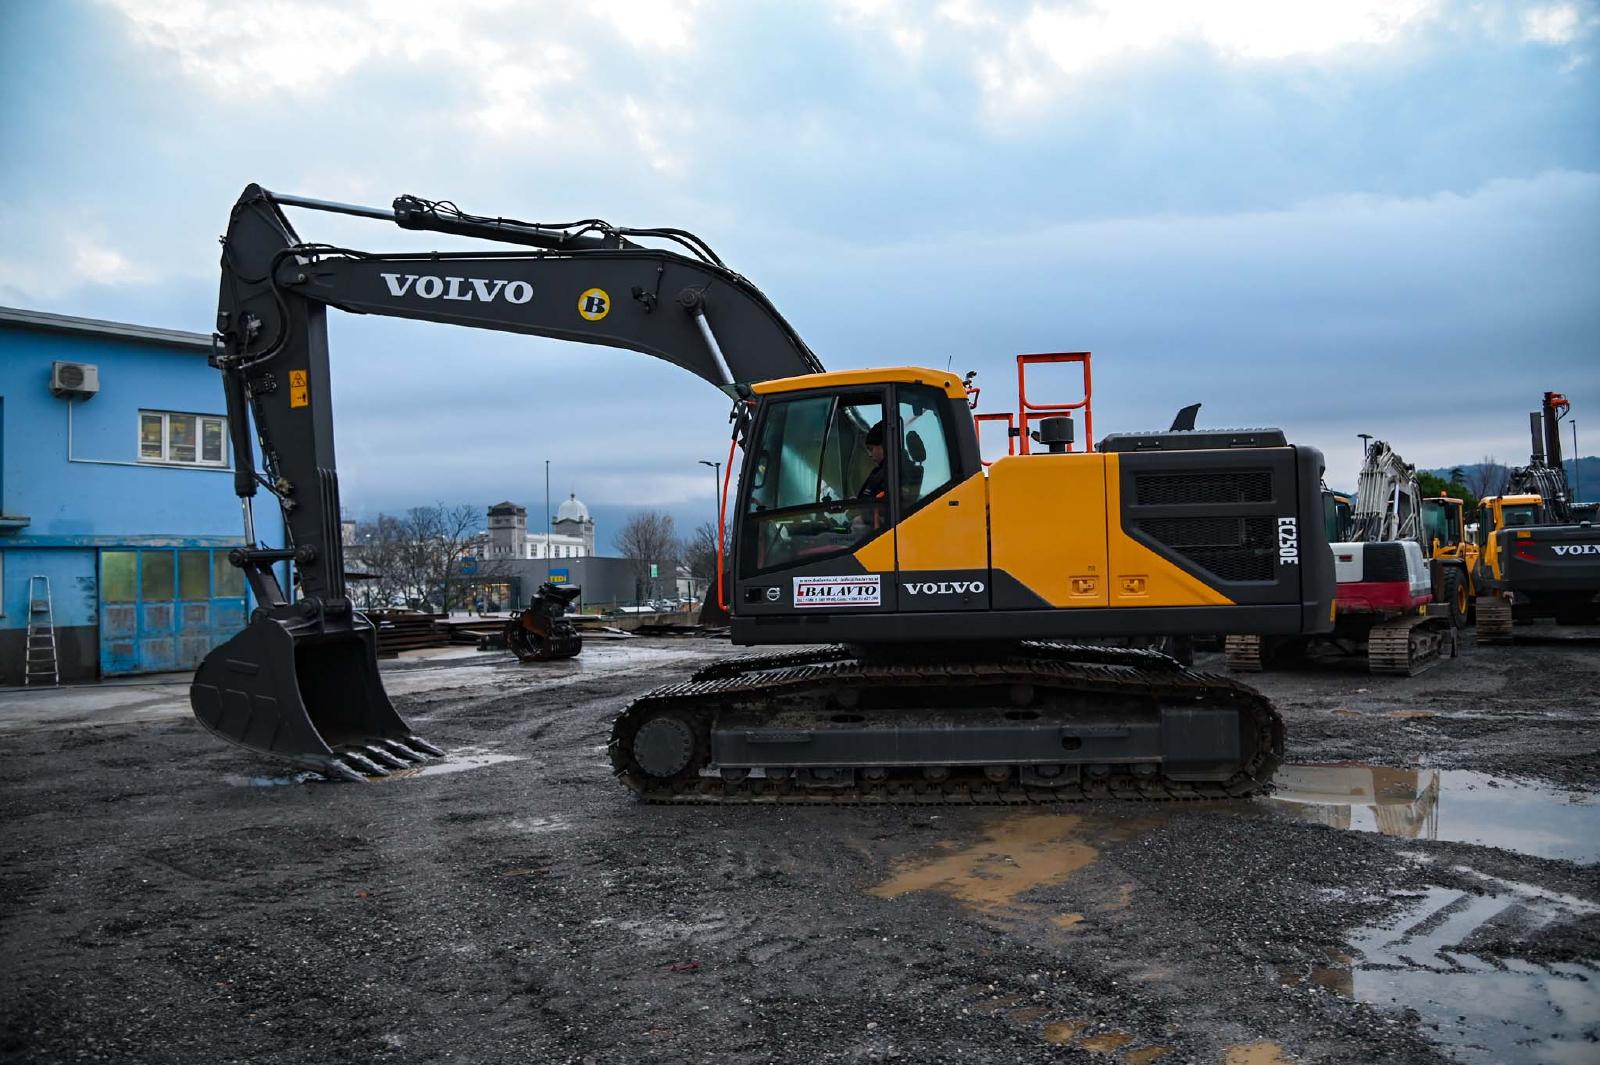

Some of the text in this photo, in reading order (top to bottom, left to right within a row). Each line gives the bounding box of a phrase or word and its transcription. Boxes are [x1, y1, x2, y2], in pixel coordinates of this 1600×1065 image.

[380, 273, 534, 304] VOLVO
[584, 295, 606, 314] B
[1278, 517, 1299, 565] EC250E
[805, 585, 877, 597] BALAVTO
[902, 581, 985, 595] VOLVO
